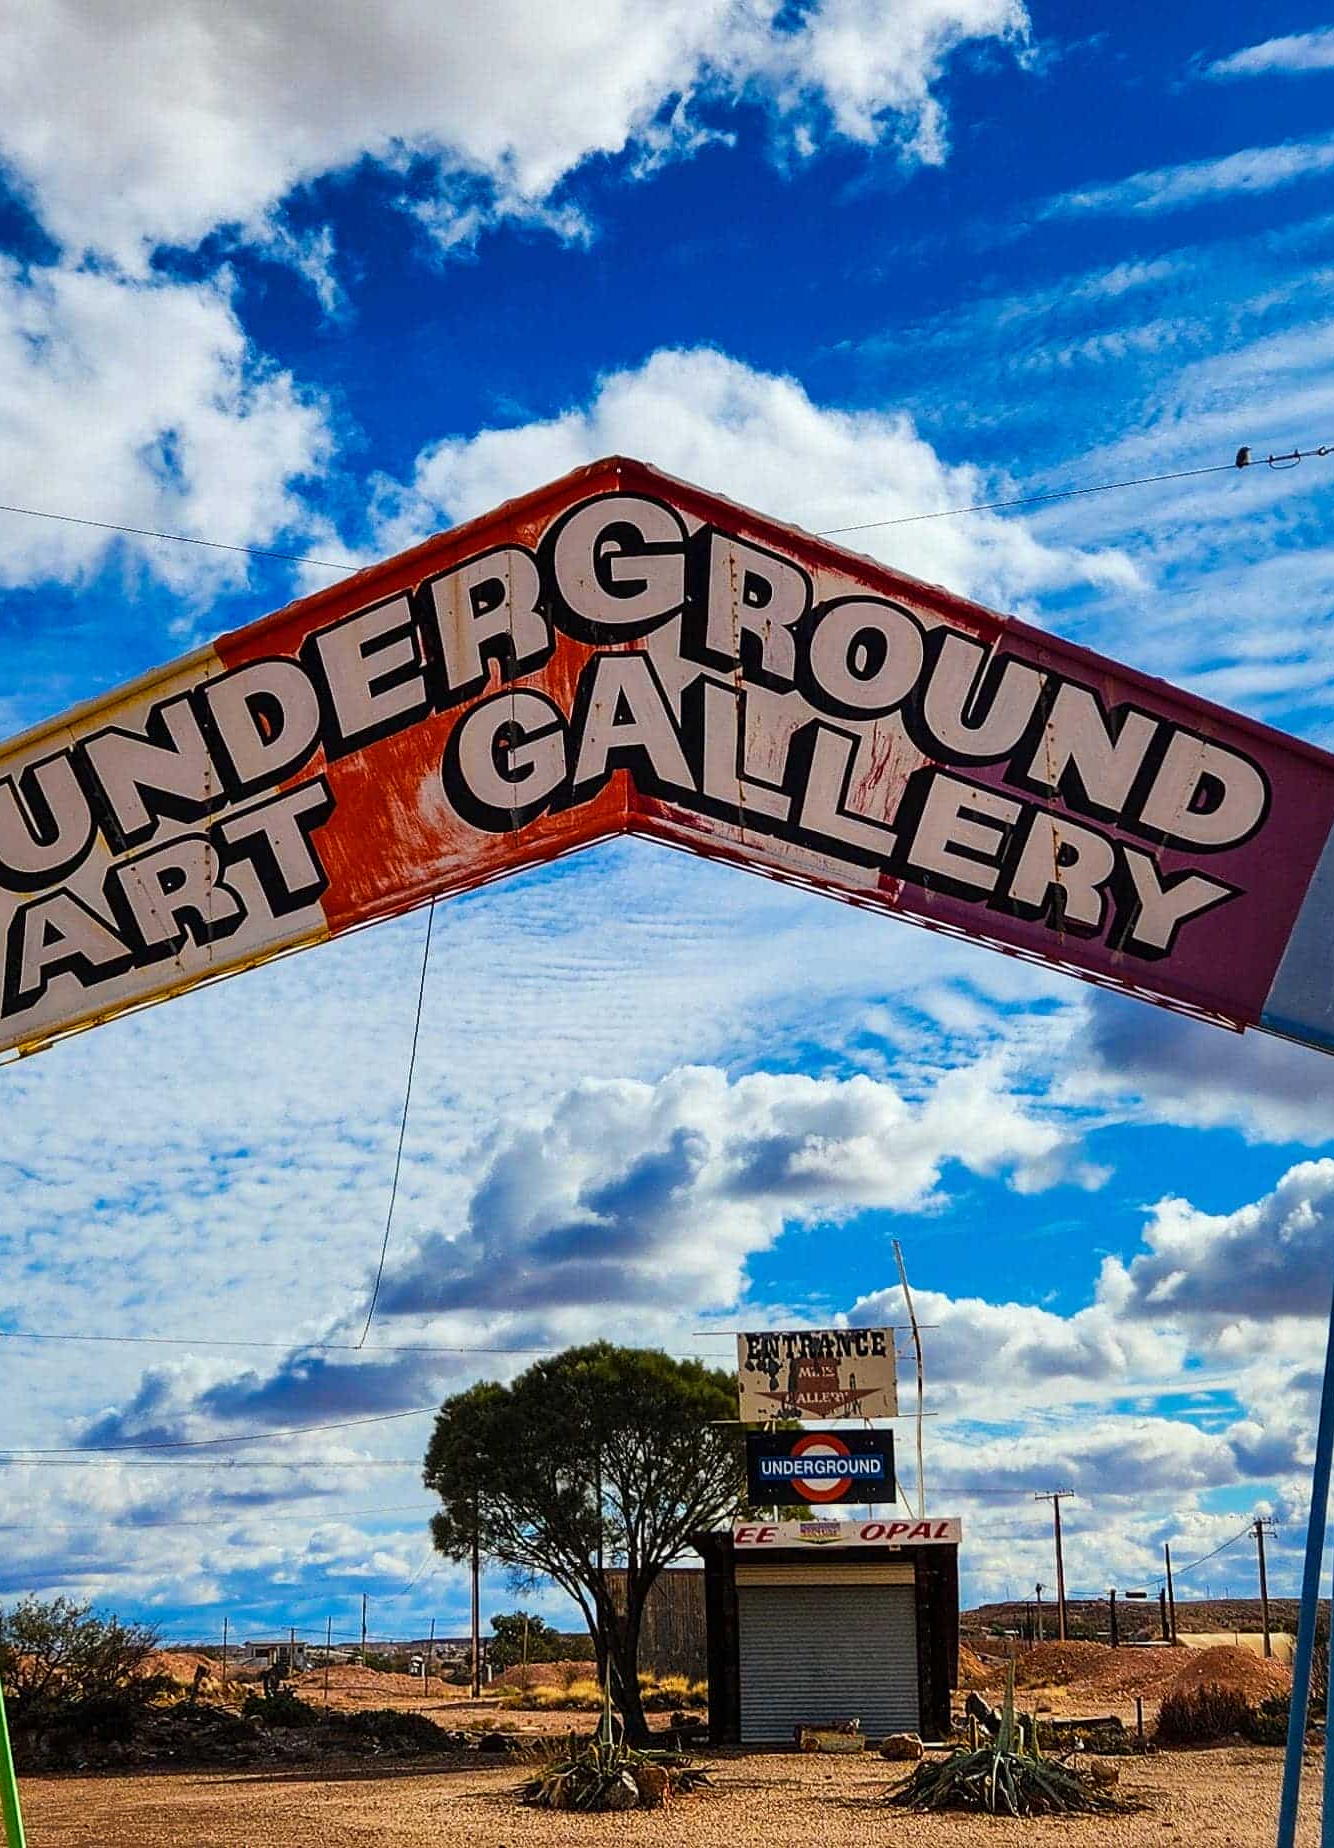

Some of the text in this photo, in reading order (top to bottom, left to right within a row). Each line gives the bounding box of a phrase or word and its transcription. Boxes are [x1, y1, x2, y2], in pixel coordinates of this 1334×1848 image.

[1, 649, 1245, 1019] ART GALLERY
[746, 1330, 887, 1359] ENTRANCE
[784, 1391, 848, 1405] ALLE
[761, 1459, 881, 1475] UNDERGROUND
[859, 1521, 951, 1541] OPAL
